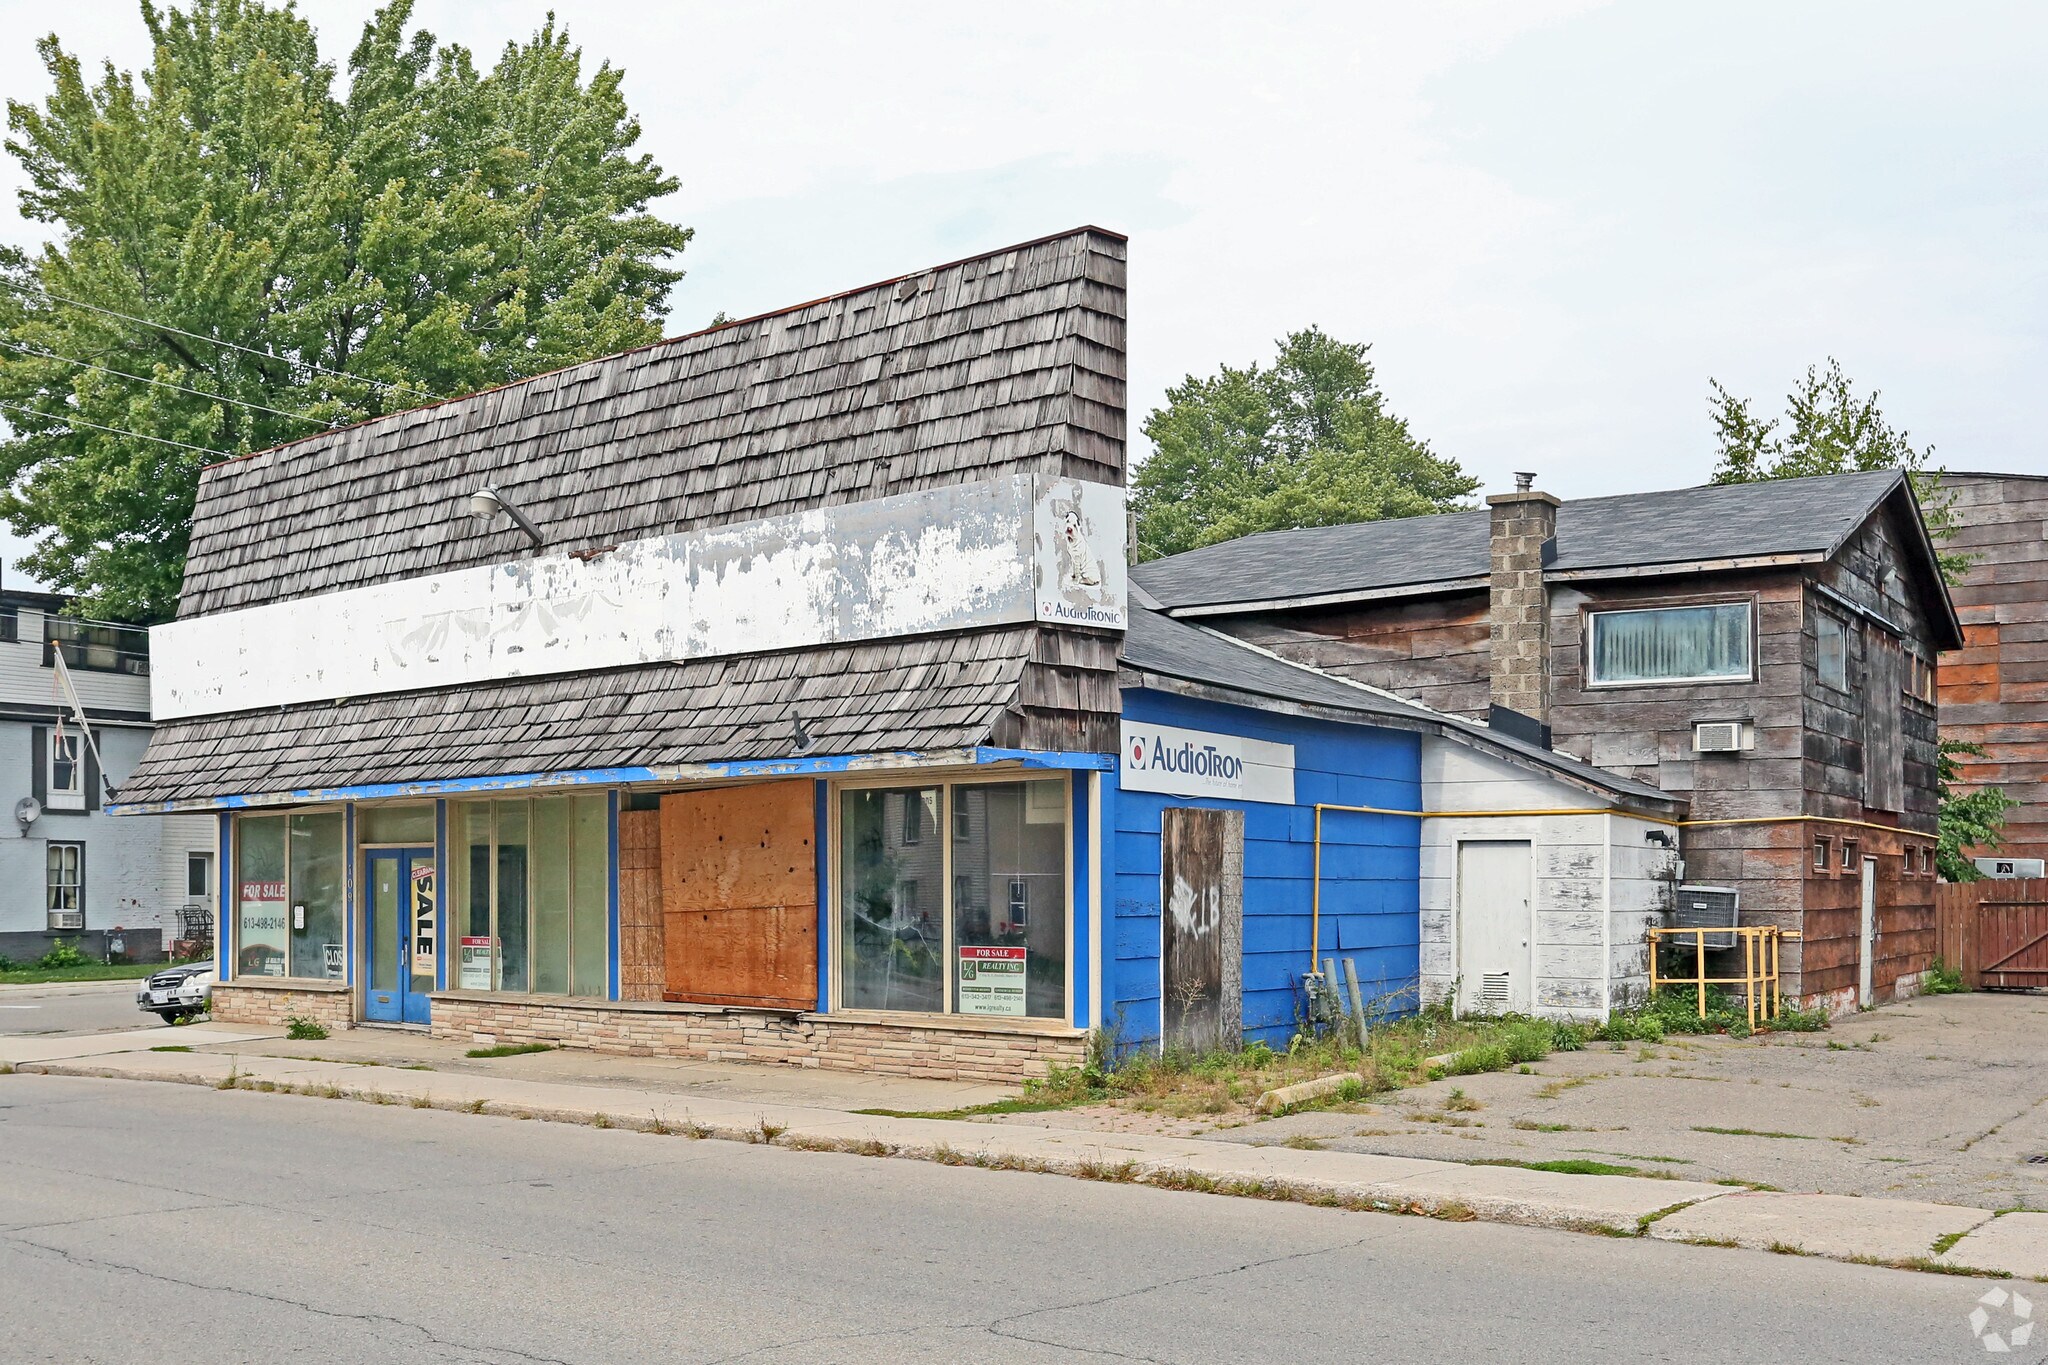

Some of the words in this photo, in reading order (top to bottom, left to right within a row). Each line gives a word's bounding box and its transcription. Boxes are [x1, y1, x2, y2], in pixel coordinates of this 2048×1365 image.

[243, 884, 261, 898] FOR
[262, 884, 285, 898] SALE
[417, 876, 433, 955] SALE
[243, 917, 285, 930] 613-498-2146
[976, 949, 991, 957] FOR
[991, 949, 1009, 957] SALE
[982, 962, 1006, 970] REALTY
